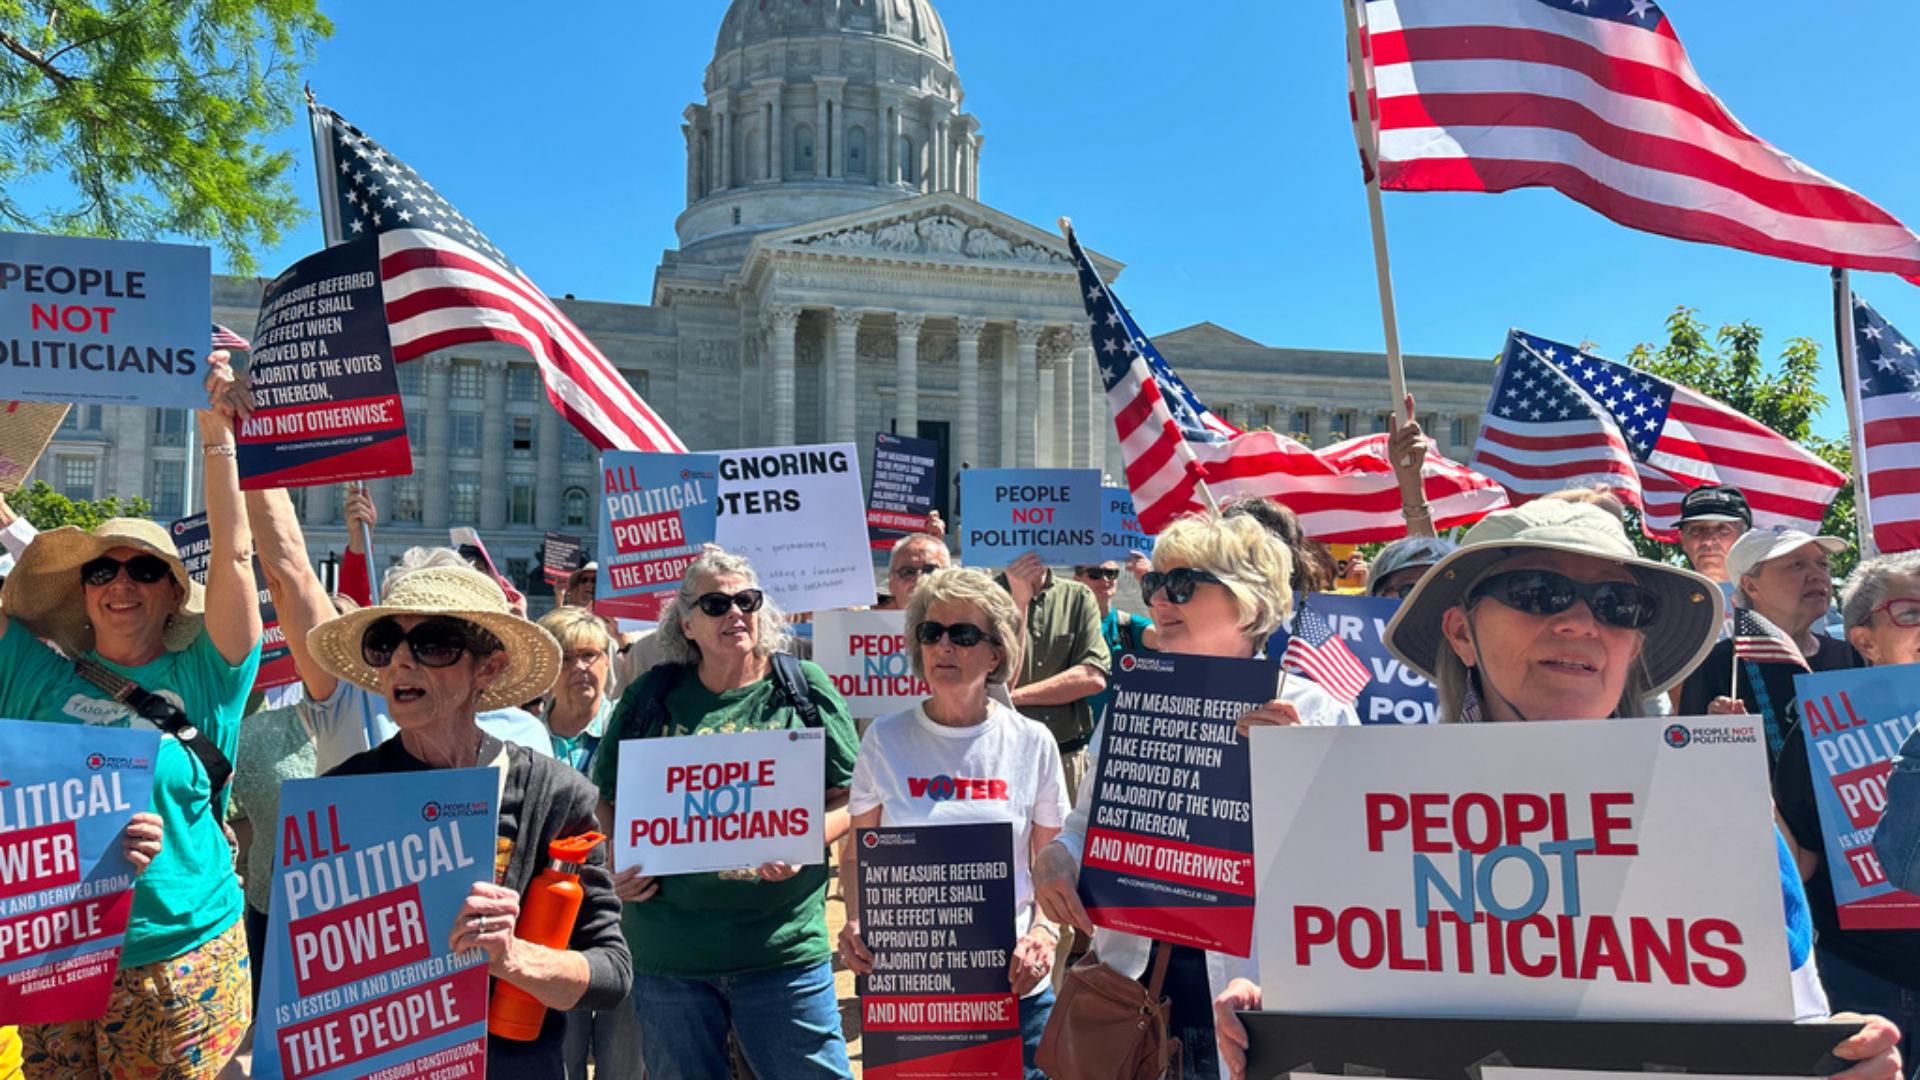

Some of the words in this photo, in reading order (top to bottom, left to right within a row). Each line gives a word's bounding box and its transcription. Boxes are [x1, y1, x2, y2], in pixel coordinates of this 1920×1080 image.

[0, 262, 146, 299] PEOPLE
[318, 271, 375, 296] REFERRED
[31, 303, 117, 334] NOT
[278, 301, 315, 324] PEOPLE
[318, 295, 354, 311] SHALL
[269, 322, 304, 344] EFFECT
[307, 317, 342, 337] WHEN
[251, 343, 299, 366] PPROVED
[301, 341, 316, 358] BY
[319, 340, 329, 356] A
[251, 365, 299, 386] AJORITY
[302, 363, 317, 380] OF
[320, 360, 343, 378] THE
[344, 354, 382, 375] VOTES
[272, 383, 333, 405] THEREON,
[241, 416, 273, 438] AND
[276, 412, 305, 435] NOT
[605, 465, 642, 495] ALL
[719, 451, 849, 481] GNORING
[607, 480, 707, 520] POLITICAL
[995, 485, 1070, 502] PEOPLE
[1012, 507, 1055, 524] NOT
[614, 517, 682, 548] POWER
[970, 530, 1094, 547] POLITICIANS
[611, 565, 642, 588] THE
[849, 635, 909, 656] PEOP
[864, 651, 908, 681] NO
[1141, 694, 1202, 717] MEASURE
[1803, 691, 1867, 737] ALL
[1113, 713, 1127, 732] TO
[1129, 715, 1150, 735] THE
[1152, 718, 1197, 741] PEOPLE
[1200, 723, 1238, 745] SHALL
[1692, 727, 1729, 735] PEOPLE
[1731, 727, 1755, 735] NOT
[1692, 735, 1757, 743] POLITICIANS
[1109, 736, 1138, 757] TAKE
[1139, 739, 1182, 763] EFFECT
[1184, 745, 1223, 767] WHEN
[667, 759, 775, 793] PEOPLE
[907, 774, 1009, 801] VOTER
[1104, 759, 1171, 785] APPROVED
[1172, 768, 1188, 787] BY
[1190, 770, 1200, 789] A
[0, 772, 130, 833] LITICAL
[684, 780, 760, 825] NOT
[1100, 781, 1167, 810] MAJORITY
[1167, 792, 1183, 812] OF
[1186, 794, 1209, 816] THE
[1211, 798, 1250, 822] VOTES
[282, 804, 350, 866] ALL
[630, 808, 809, 848] POLITICIANS
[1097, 806, 1128, 829] CAST
[1130, 810, 1190, 842] THEREON,
[1364, 791, 1639, 856] PEOPLE
[0, 834, 76, 885] WER
[1089, 836, 1122, 862] AND
[1123, 843, 1154, 868] NOT
[284, 820, 475, 921] POLITICAL
[892, 864, 947, 883] MEASURE
[950, 862, 1007, 881] REFERRED
[1412, 837, 1597, 928] NOT
[10, 896, 37, 914] AND
[39, 882, 92, 906] DERIVED
[95, 874, 130, 893] FROM
[865, 888, 880, 905] TO
[881, 887, 902, 904] THE
[905, 886, 948, 903] PEOPLE
[950, 884, 986, 902] SHALL
[0, 903, 102, 959] PEOPLE
[866, 909, 894, 926] TAKE
[896, 908, 936, 926] EFFECT
[937, 907, 973, 925] WHEN
[295, 899, 425, 981] POWER
[868, 930, 928, 948] APPROVED
[931, 930, 946, 947] BY
[948, 930, 957, 946] A
[1292, 904, 1748, 989] POLITICIANS
[929, 952, 944, 969] OF
[947, 951, 968, 969] THE
[970, 949, 1006, 968] VOTES
[7, 965, 54, 985] MISSOURI
[20, 977, 56, 996] ARTICLE
[67, 965, 102, 984] SECTION
[103, 963, 108, 974] 1
[276, 1005, 291, 1025] IS
[291, 991, 341, 1020] VESTED
[344, 985, 360, 1003] IN
[361, 976, 389, 999] AND
[391, 956, 444, 991] DERIVED
[447, 947, 484, 970] FROM
[868, 974, 897, 992] CAST
[899, 974, 955, 993] THEREON,
[867, 1003, 896, 1024] AND
[899, 1003, 925, 1024] NOT
[284, 1020, 346, 1076] THE
[350, 983, 460, 1055] PEOPLE
[469, 1060, 475, 1073] 1
